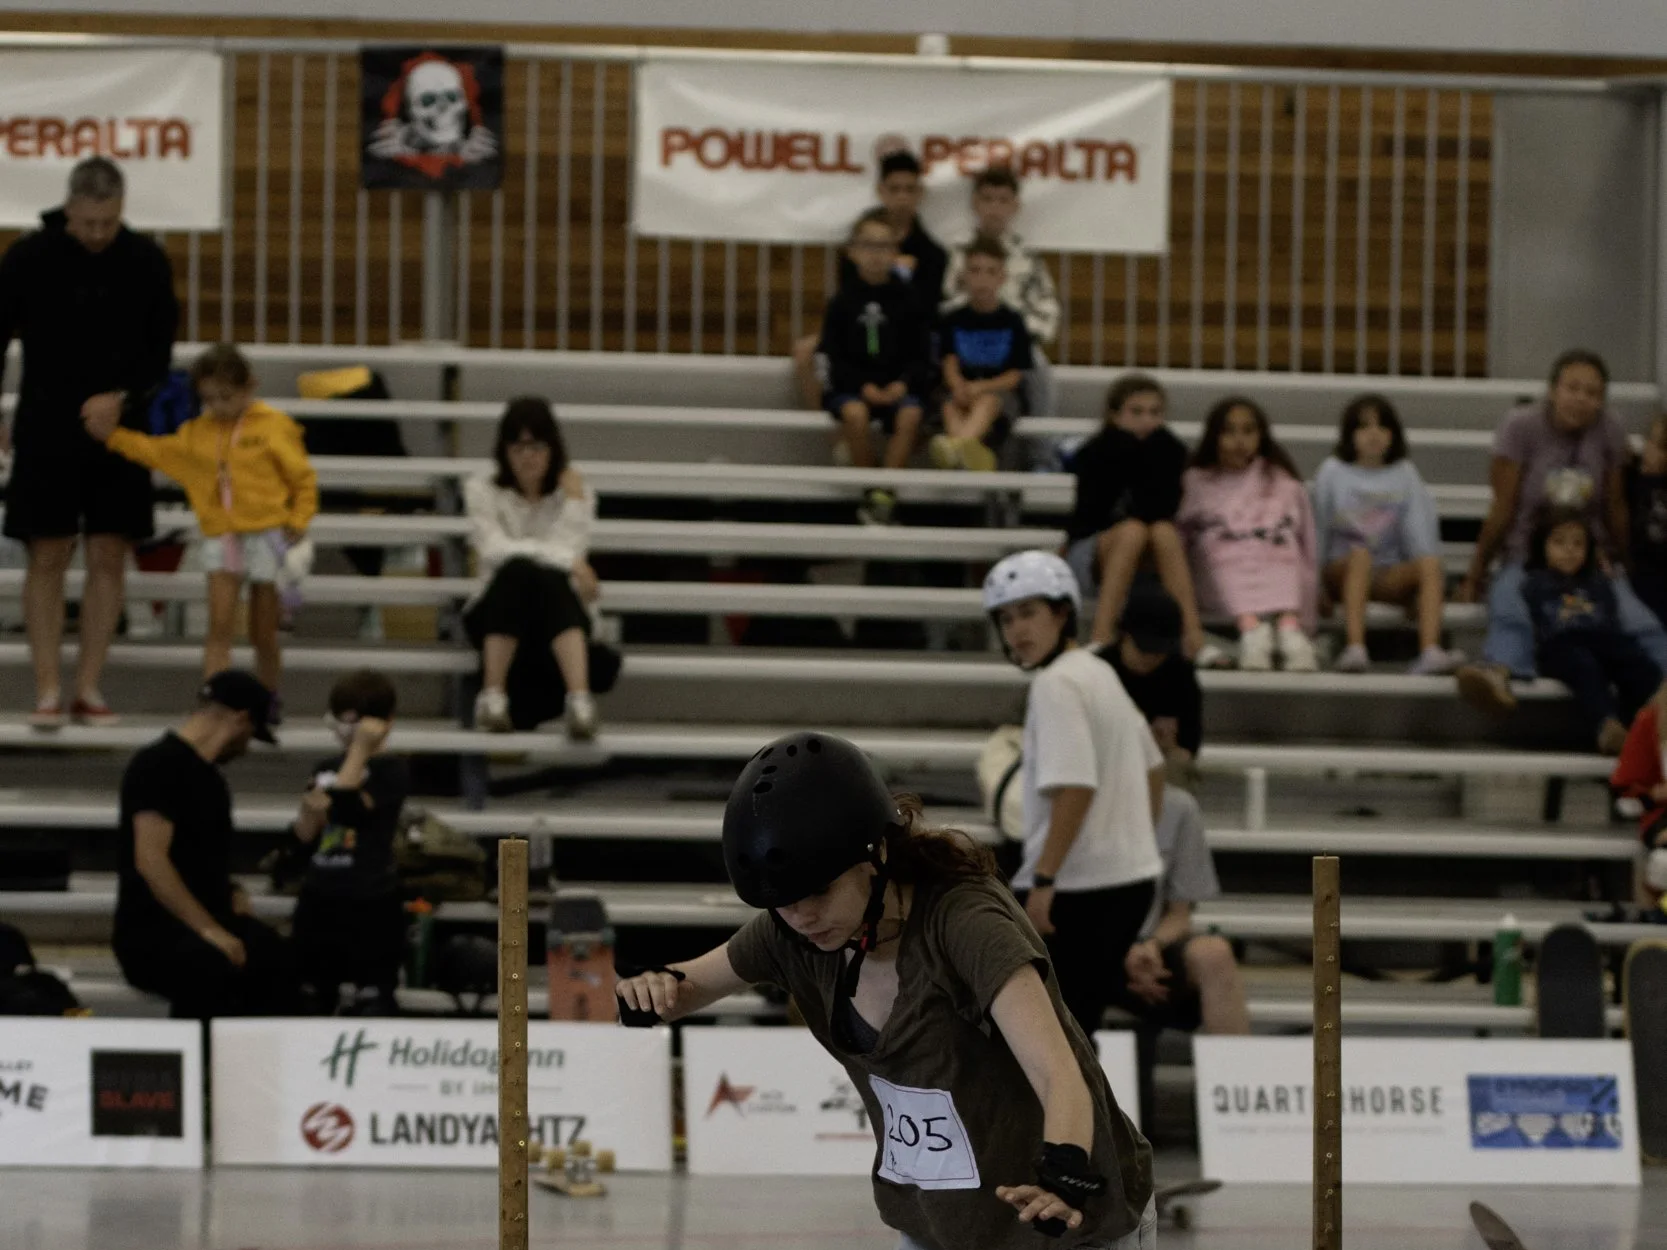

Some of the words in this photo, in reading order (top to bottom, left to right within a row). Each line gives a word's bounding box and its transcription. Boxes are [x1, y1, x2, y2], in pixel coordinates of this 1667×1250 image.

[0, 116, 191, 158] ERALTA
[660, 127, 864, 174] POWELL
[1213, 1085, 1444, 1114] QUARTHORSE
[369, 1112, 586, 1147] LANDYAHTZ
[887, 1104, 953, 1152] 205
